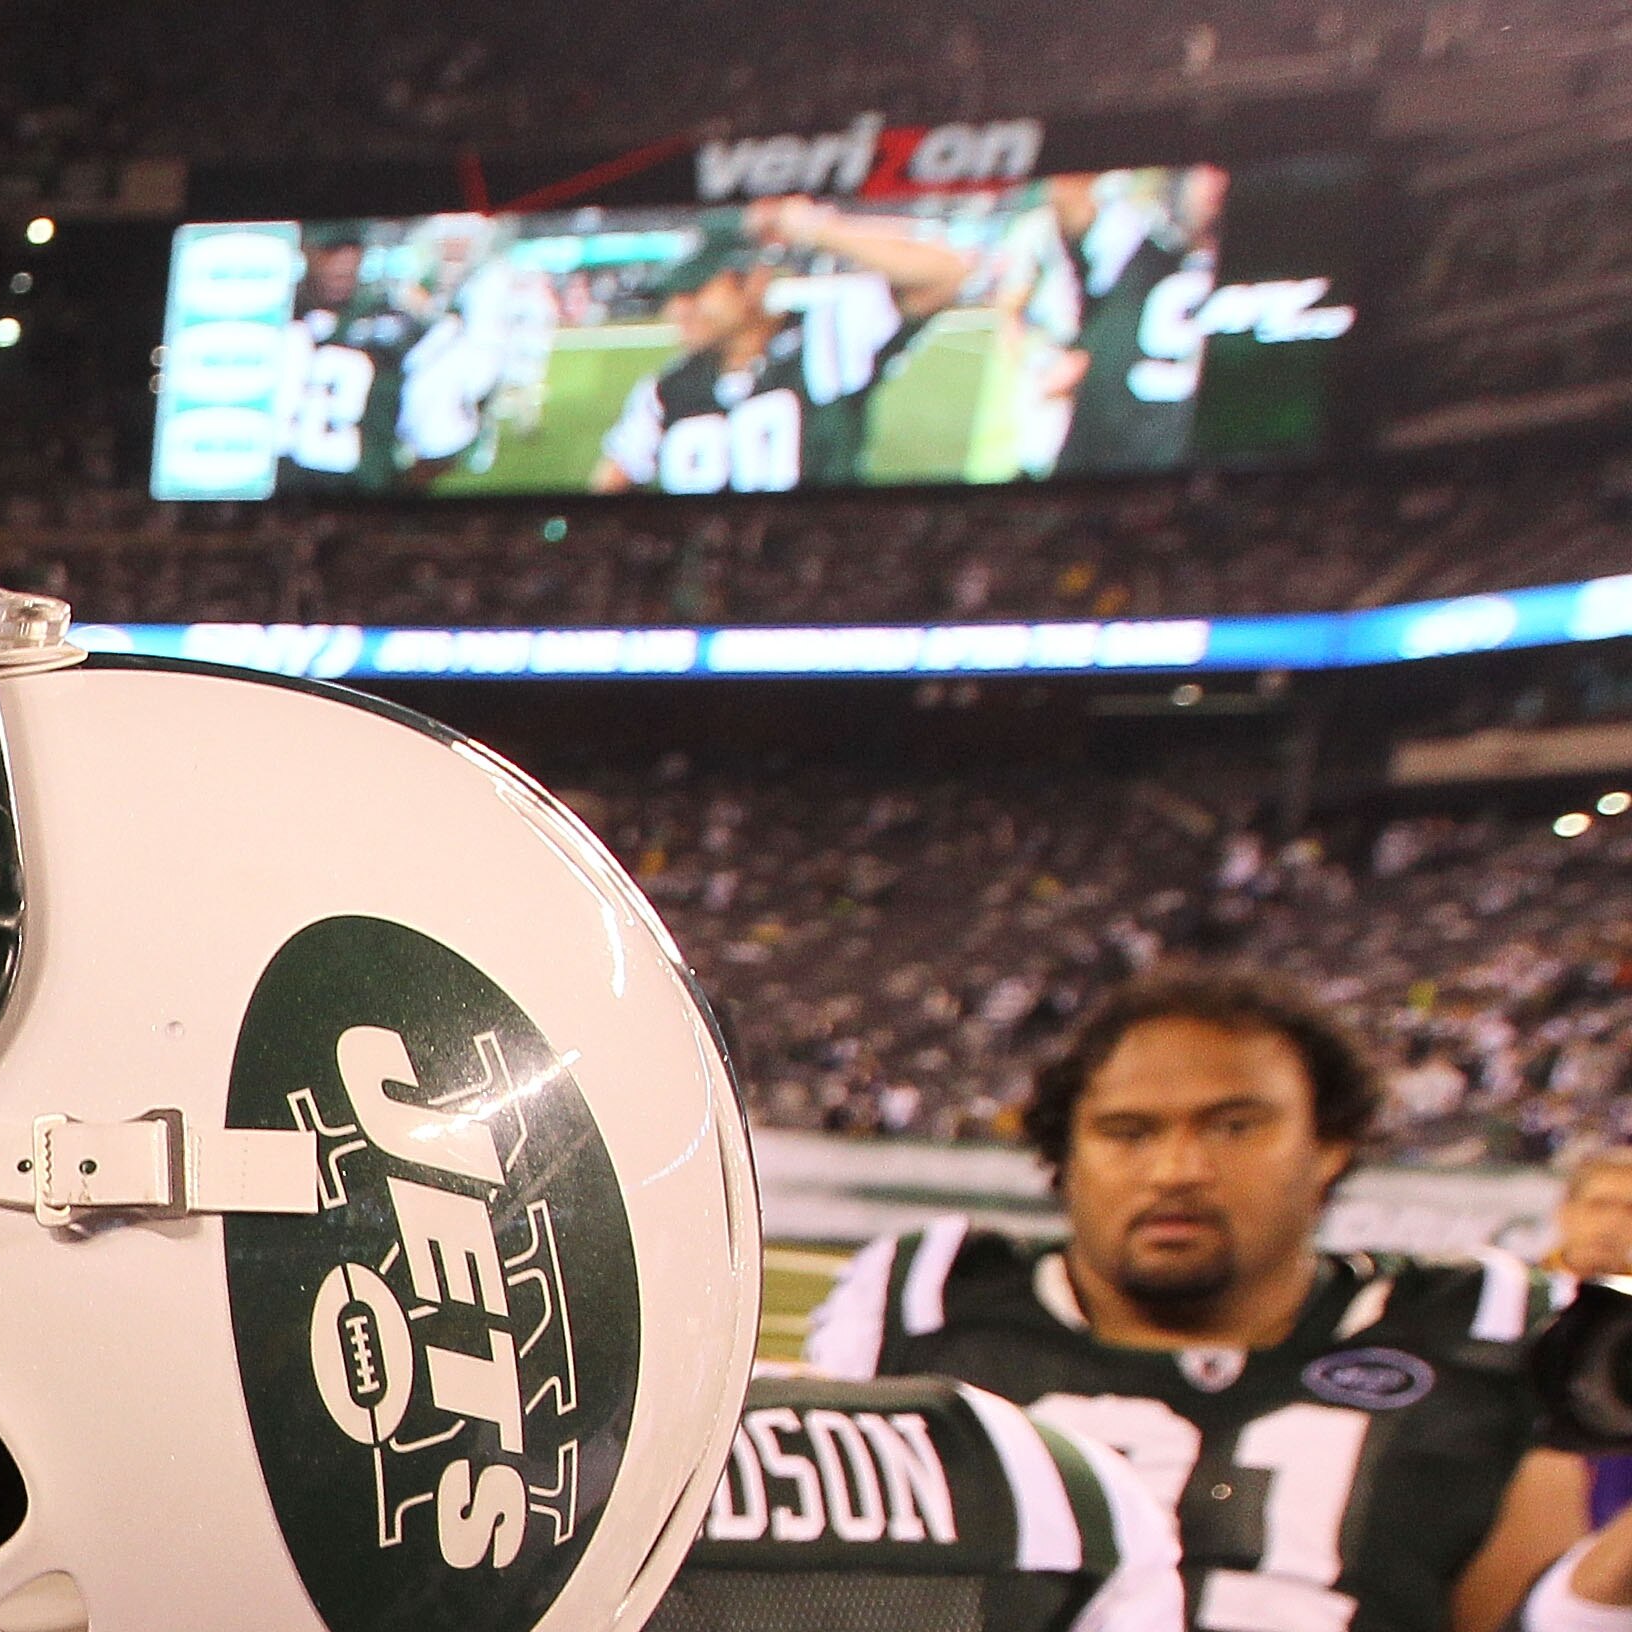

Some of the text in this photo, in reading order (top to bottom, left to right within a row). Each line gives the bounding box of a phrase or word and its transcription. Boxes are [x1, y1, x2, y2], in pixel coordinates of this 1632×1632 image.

[695, 110, 1044, 200] verizon
[336, 1025, 527, 1570] JETS
[696, 1406, 959, 1545] DSON
